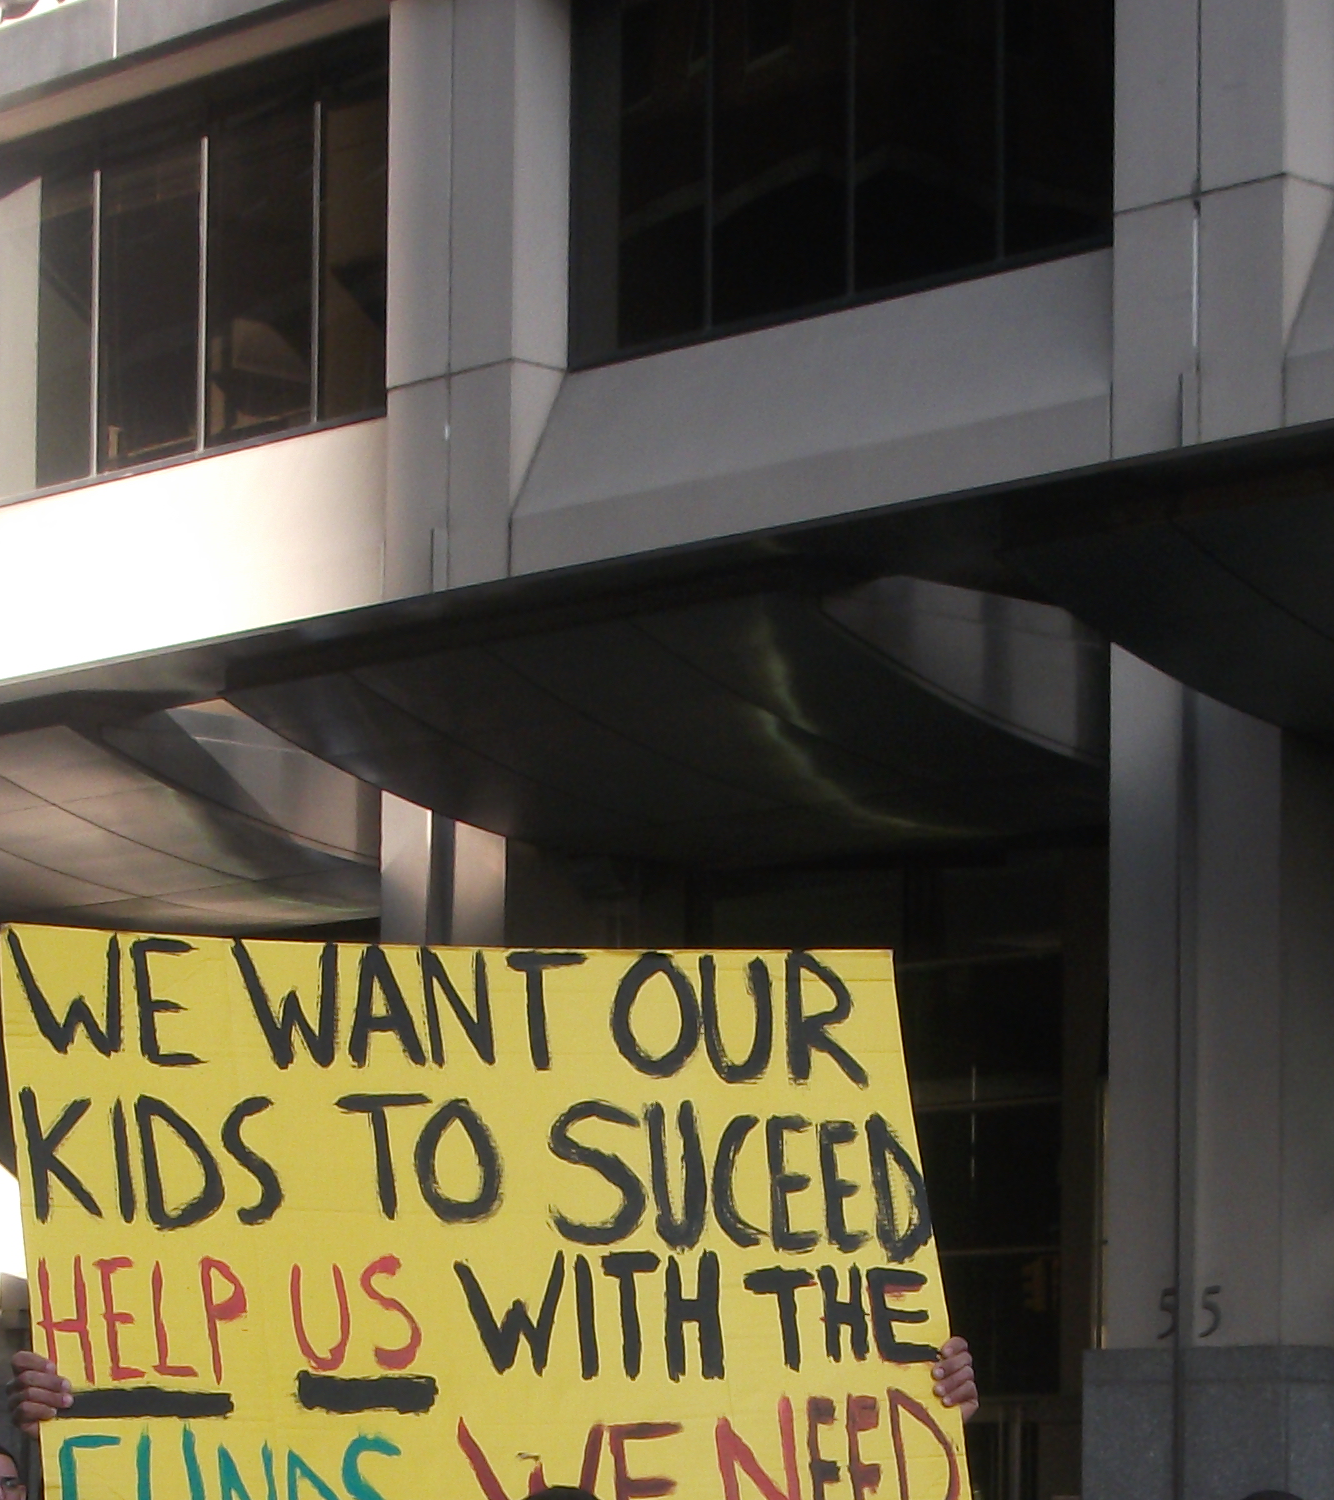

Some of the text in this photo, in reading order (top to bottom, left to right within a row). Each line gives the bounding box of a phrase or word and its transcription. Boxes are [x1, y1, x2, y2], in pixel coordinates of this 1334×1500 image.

[7, 928, 870, 1089] WE WANT OUR
[18, 1085, 934, 1263] KIDS TO SUCEED
[37, 1248, 942, 1385] HELP US WITH THE
